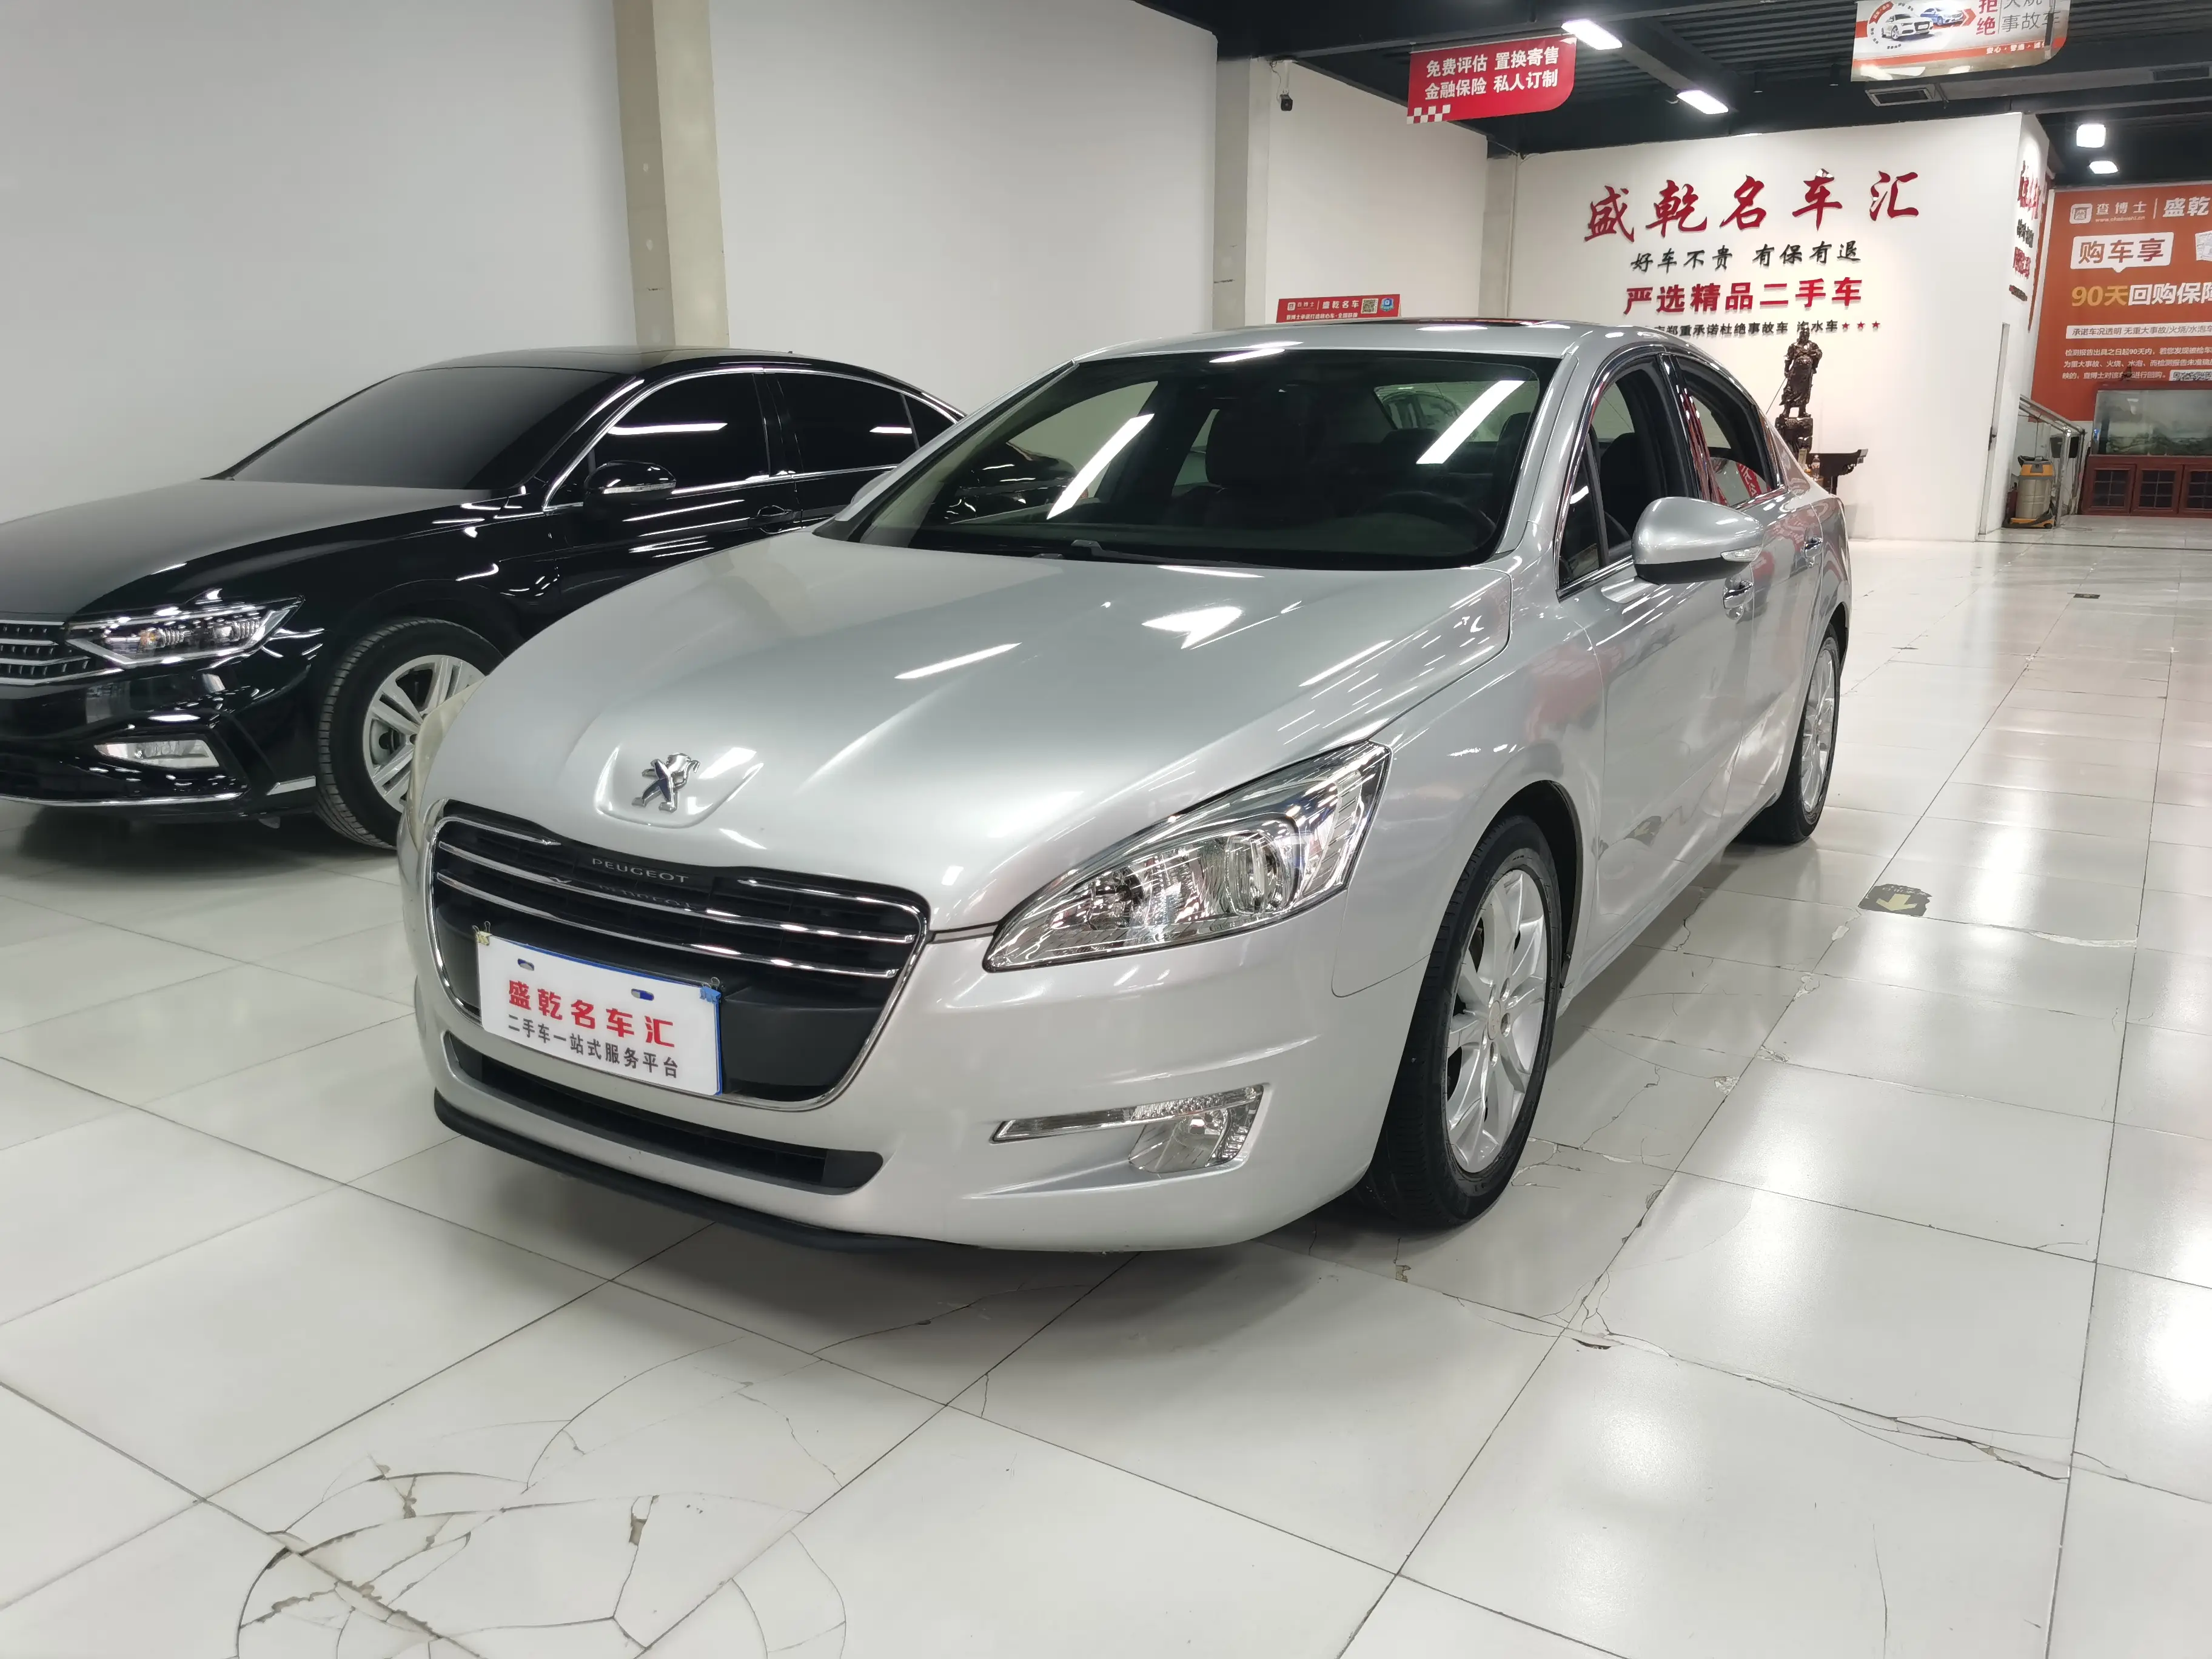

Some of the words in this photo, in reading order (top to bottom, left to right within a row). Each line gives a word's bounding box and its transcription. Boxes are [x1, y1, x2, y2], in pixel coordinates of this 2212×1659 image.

[1426, 55, 1487, 78] 免费评估
[1495, 46, 1559, 70] 置换寄售
[1425, 78, 1487, 100] 金融保险
[1493, 69, 1558, 93] 私人订制
[1584, 169, 1919, 243] 盛乾名车汇
[2096, 201, 2147, 215] 查博士
[2162, 196, 2211, 217] 盛乾
[1630, 244, 1733, 273] 好车不贵
[1752, 240, 1862, 268] 有保有退
[2078, 238, 2165, 264] 购车享
[1623, 276, 1863, 315] 严选精品二手车
[592, 858, 689, 883] PEUGEOT
[508, 979, 675, 1048] 盛乾名车汇
[508, 1014, 679, 1079] 二手车一站式服务平台
